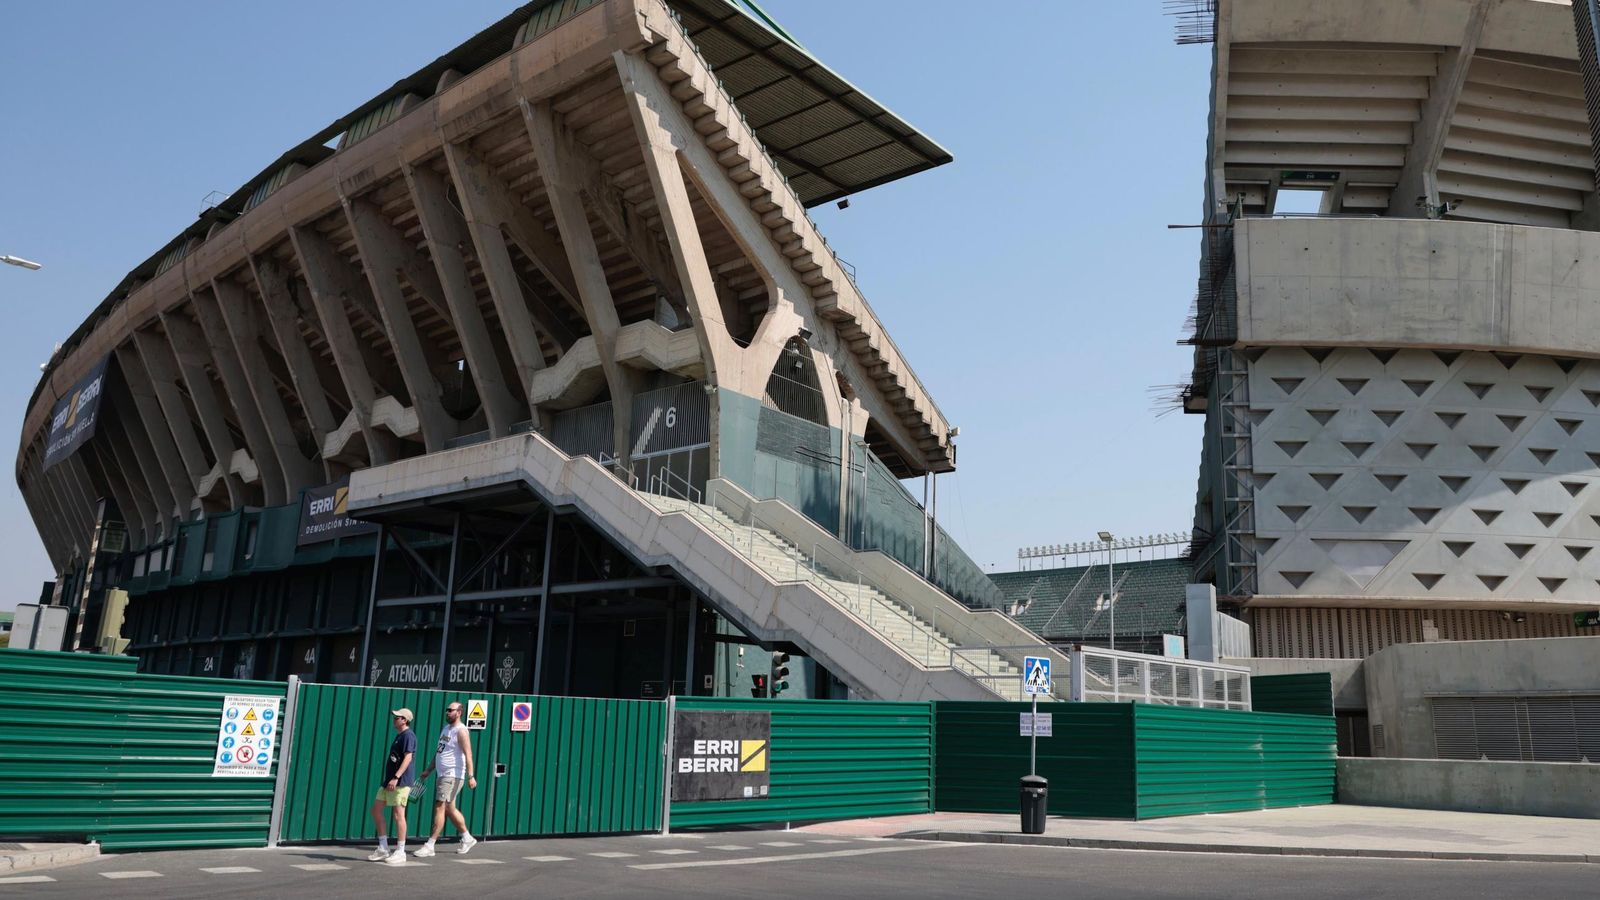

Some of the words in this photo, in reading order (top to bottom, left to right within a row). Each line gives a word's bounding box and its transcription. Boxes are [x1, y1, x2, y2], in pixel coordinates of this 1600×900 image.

[665, 406, 676, 428] 6
[310, 496, 334, 516] ERRI
[305, 518, 342, 534] DEMOLICIÓN
[345, 518, 357, 527] SIN
[304, 647, 315, 664] 4A
[349, 647, 356, 663] 4
[204, 656, 213, 671] 2A
[388, 659, 435, 683] ATENCIÓN
[693, 739, 739, 755] ERRI
[678, 757, 739, 773] BERRI
